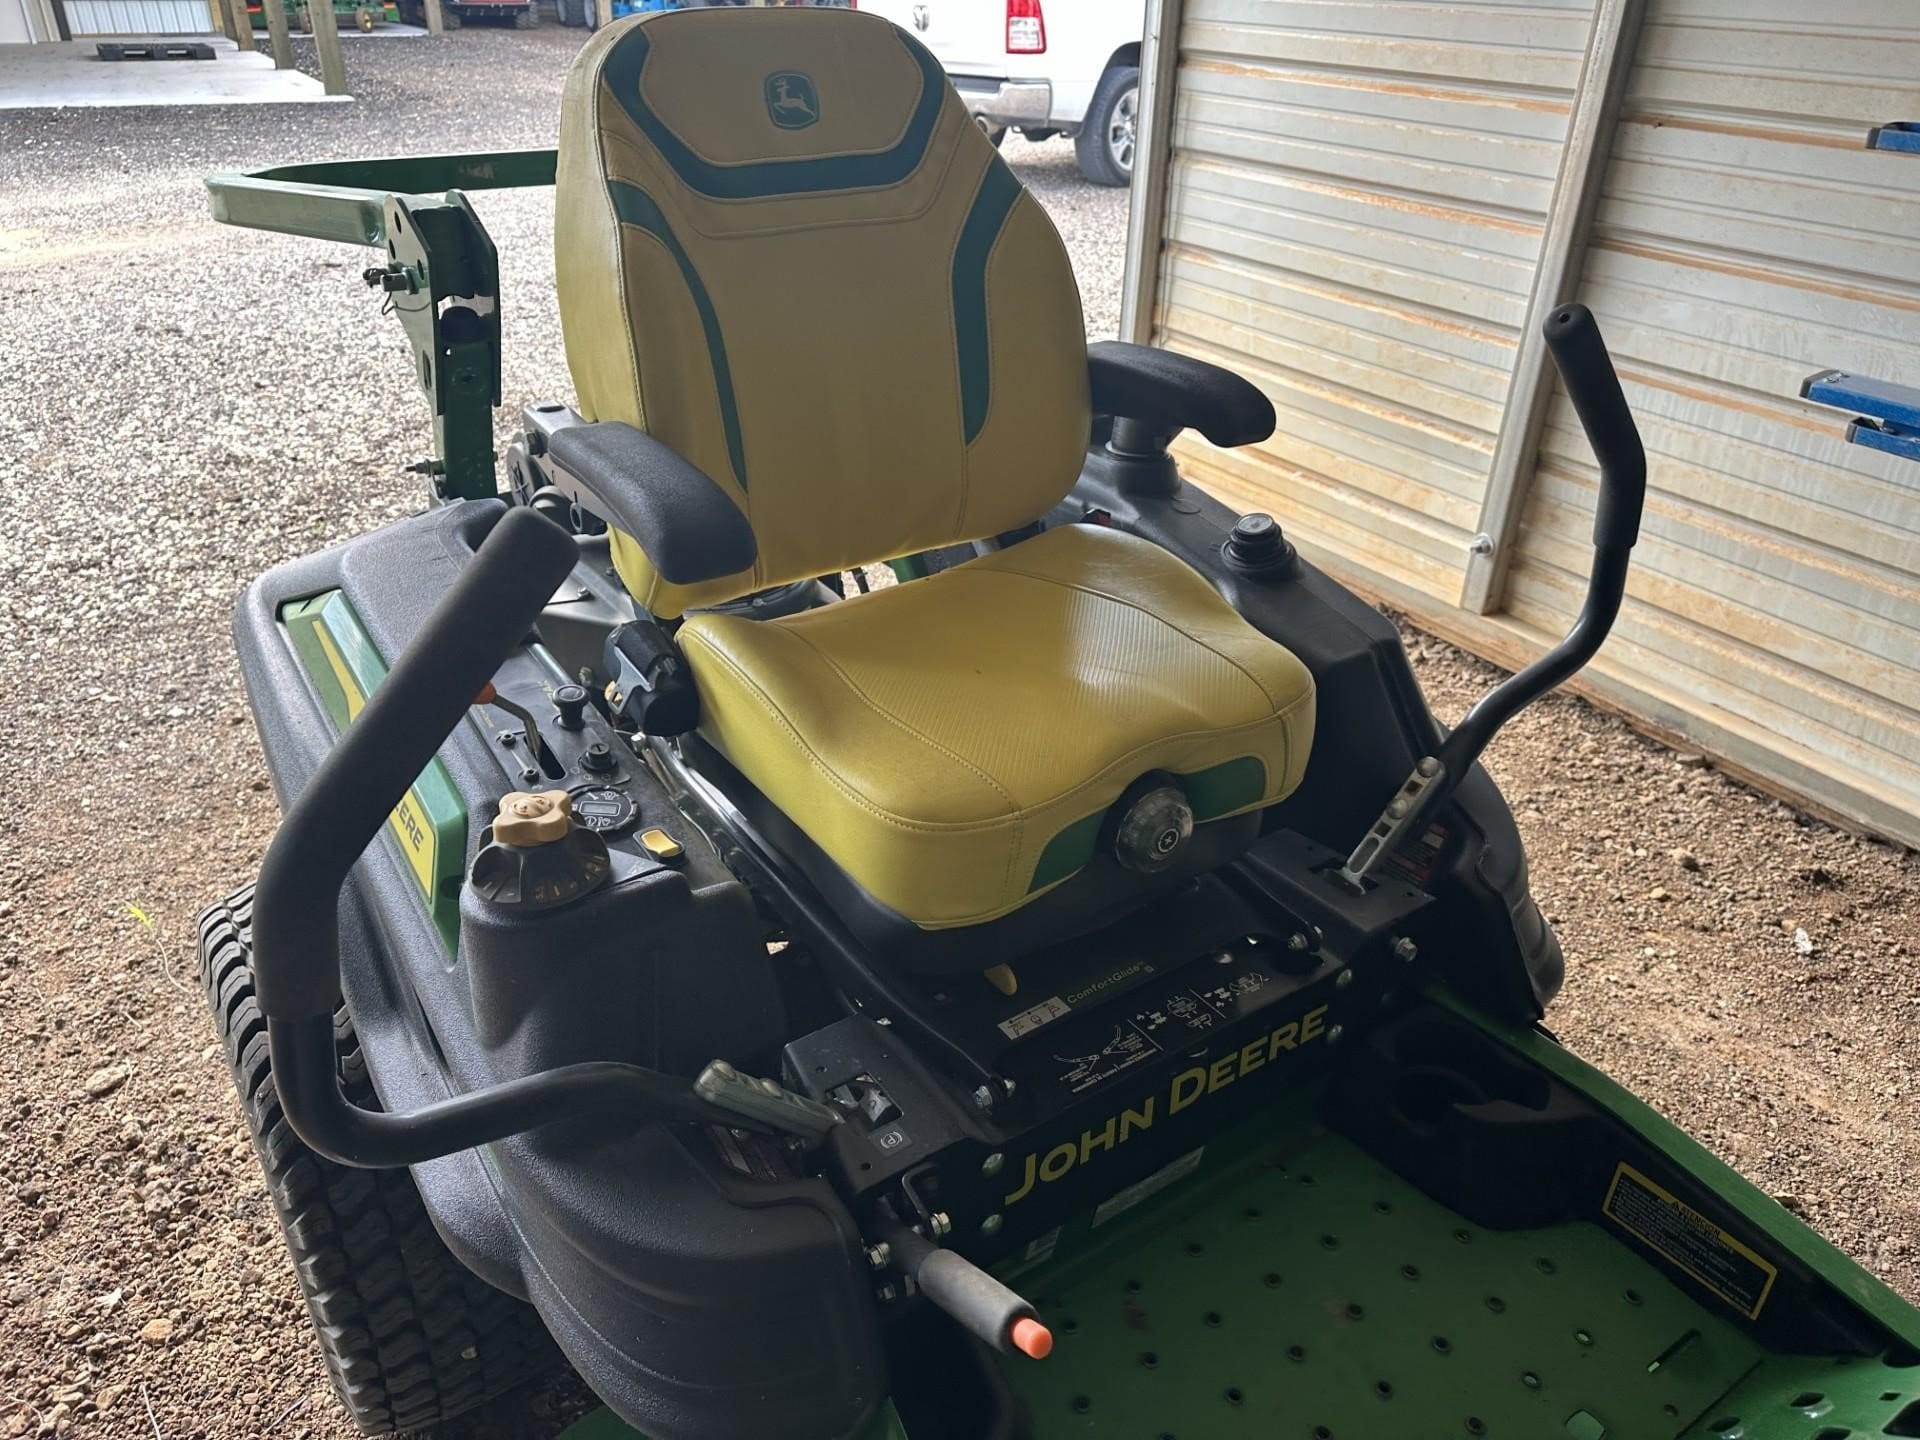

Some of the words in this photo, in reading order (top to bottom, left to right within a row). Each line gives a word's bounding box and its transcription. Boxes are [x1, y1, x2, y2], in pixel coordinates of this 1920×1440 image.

[396, 801, 424, 852] ERE
[1005, 1096, 1155, 1206] JOHN
[1169, 1004, 1329, 1115] DEERE
